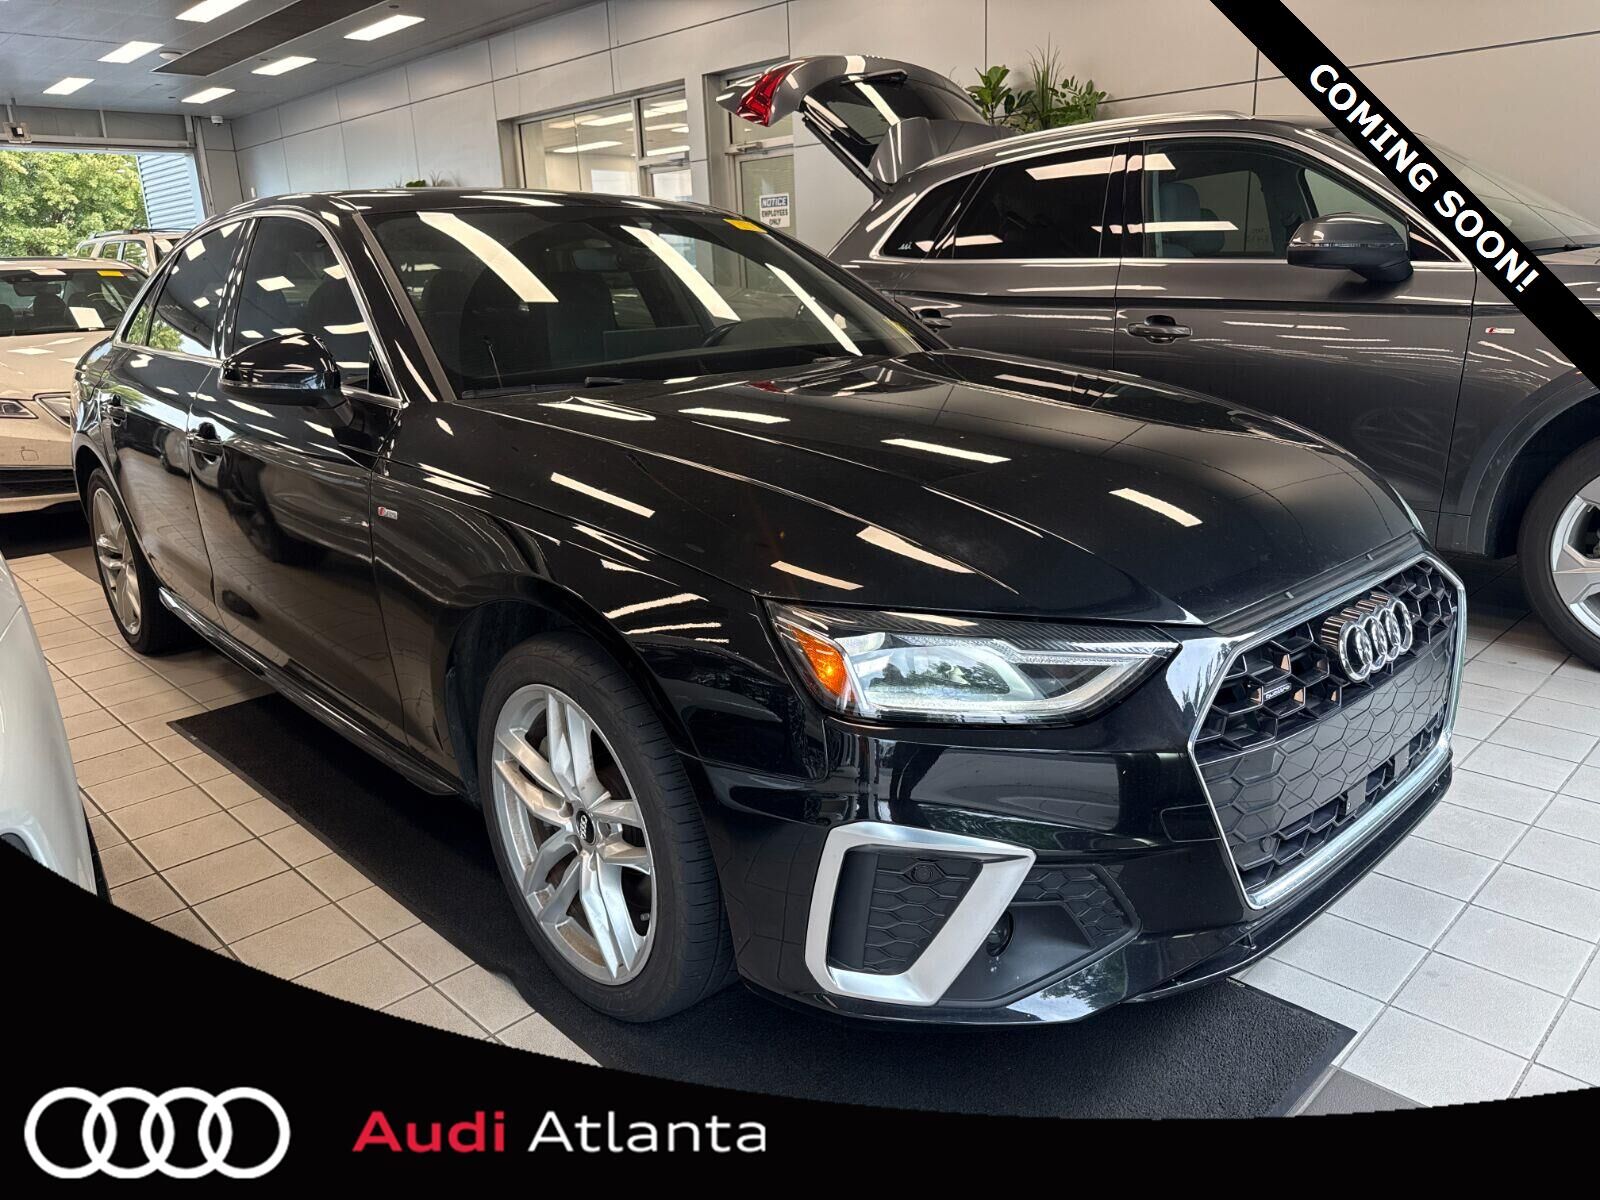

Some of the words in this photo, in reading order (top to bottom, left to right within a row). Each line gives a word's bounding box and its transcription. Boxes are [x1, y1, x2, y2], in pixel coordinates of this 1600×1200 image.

[761, 196, 788, 207] NOTICE
[761, 209, 789, 218] EMPLOYEES
[768, 218, 782, 226] ONLY
